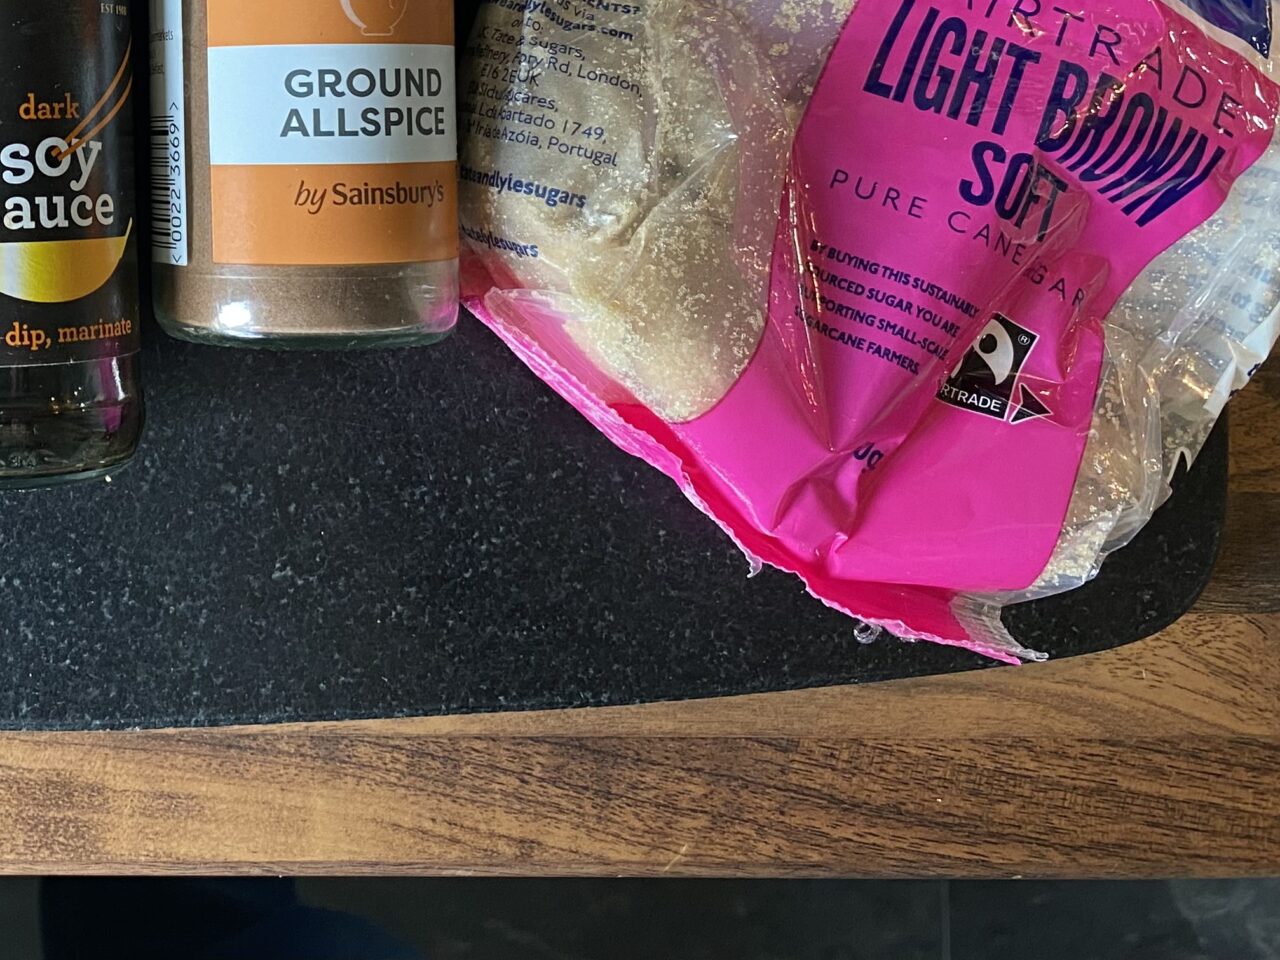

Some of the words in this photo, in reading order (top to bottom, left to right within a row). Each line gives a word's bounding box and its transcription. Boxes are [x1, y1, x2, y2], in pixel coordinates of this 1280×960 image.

[574, 5, 595, 21] via
[490, 29, 514, 44] Tate
[528, 36, 586, 61] Sugars,
[283, 68, 442, 99] GROUND
[547, 56, 572, 77] Rd,
[577, 65, 643, 98] London,
[19, 93, 80, 120] dark
[279, 106, 445, 138] ALLSPICE
[562, 120, 607, 144] 1749,
[1033, 59, 1225, 228] BROWN
[0, 136, 102, 191] soy
[547, 136, 618, 166] Portugal
[293, 180, 327, 215] by
[332, 180, 444, 209] Sainsbury's
[959, 141, 1069, 242] SOFT
[830, 169, 928, 219] PURE
[947, 211, 1026, 266] CANE
[827, 248, 880, 275] BUYING
[882, 266, 911, 286] THIS
[912, 277, 980, 319] SUSTAINABLY
[866, 288, 913, 315] SUGAR
[916, 306, 942, 327] YOU
[941, 323, 961, 338] ARE
[5, 321, 52, 350] dip,
[57, 316, 132, 343] marinate
[877, 319, 949, 361] SMALL-SCALE
